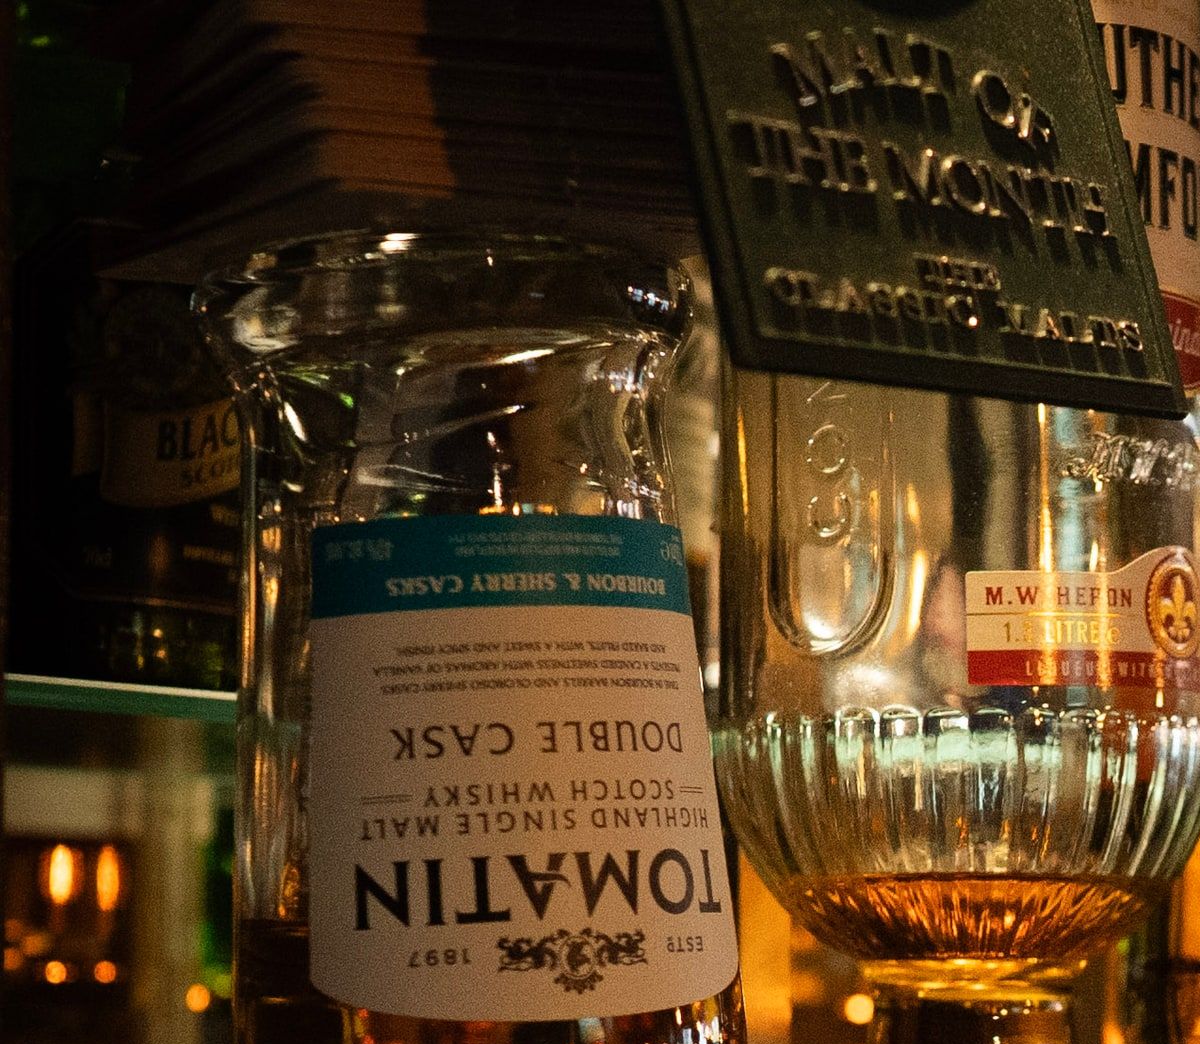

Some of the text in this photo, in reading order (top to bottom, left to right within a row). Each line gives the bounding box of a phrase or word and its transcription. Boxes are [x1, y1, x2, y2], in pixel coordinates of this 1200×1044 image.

[769, 28, 958, 107] MALT
[726, 109, 1113, 238] THE MONTH
[384, 571, 666, 598] BOURBON & SHERRY CASKS
[389, 718, 683, 761] DOUBLE CASK
[422, 778, 674, 808] SCOTCH WHISKY
[359, 805, 710, 841] HIGHLAND SINGLE MALT
[352, 846, 722, 931] TOMATIN
[406, 947, 472, 968] 1897
